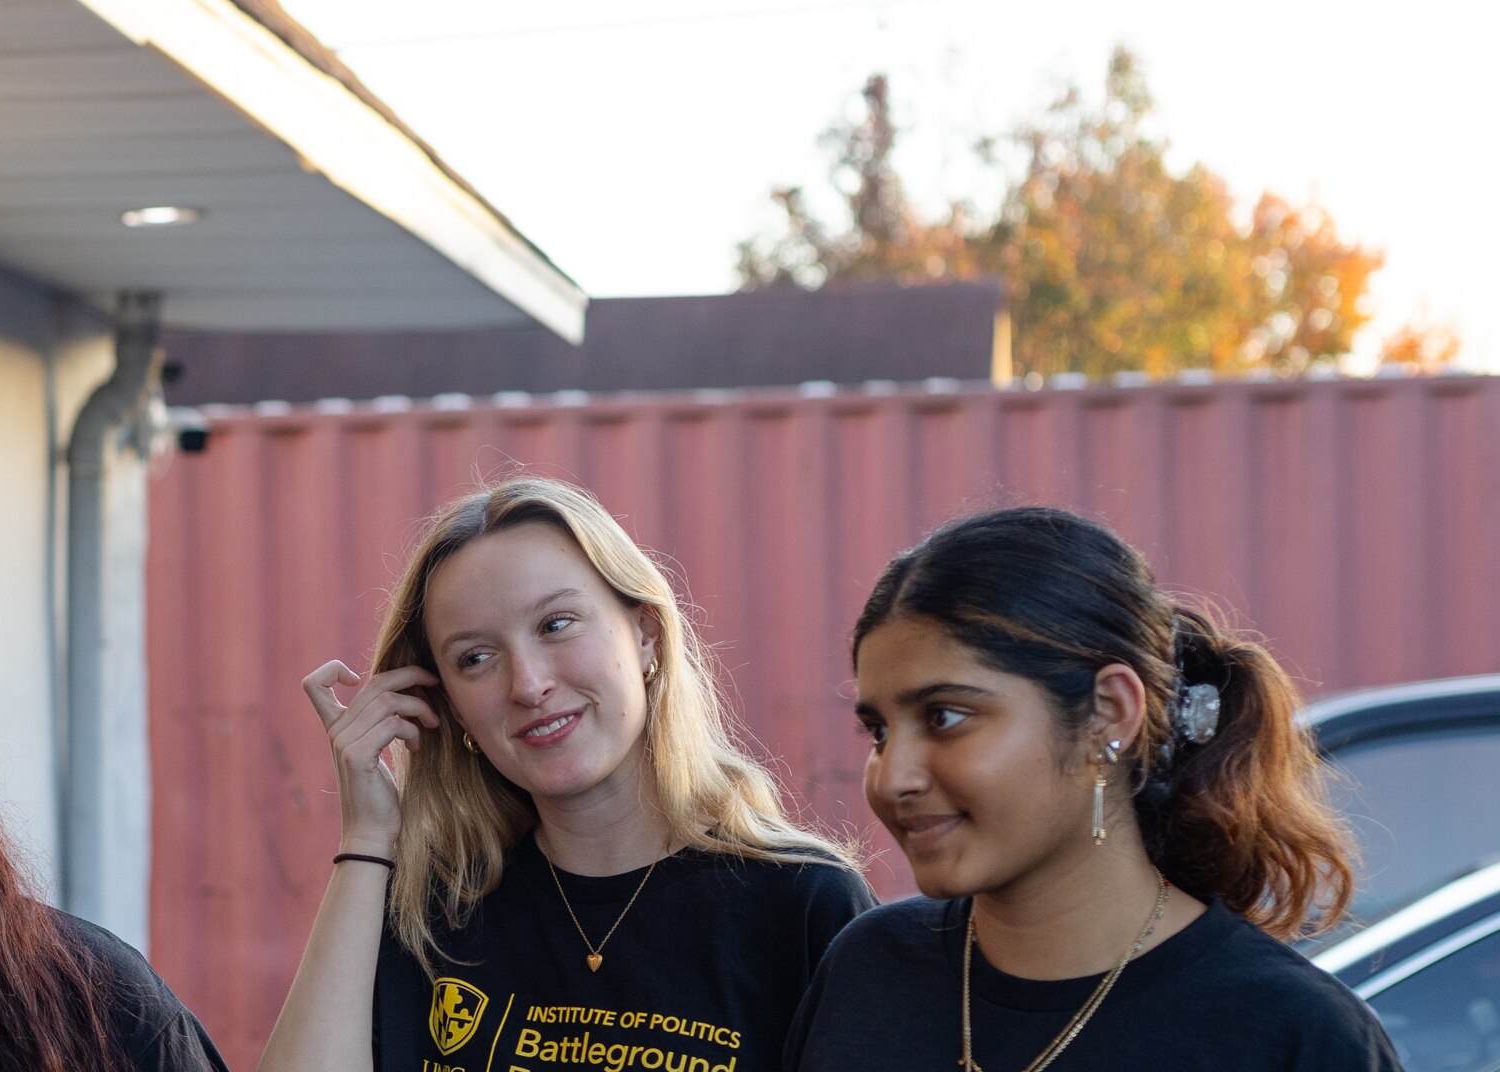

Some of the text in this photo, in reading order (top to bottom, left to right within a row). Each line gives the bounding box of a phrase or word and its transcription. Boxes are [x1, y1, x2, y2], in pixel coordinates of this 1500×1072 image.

[526, 1005, 742, 1050] INSTITUTE OF POLITICS
